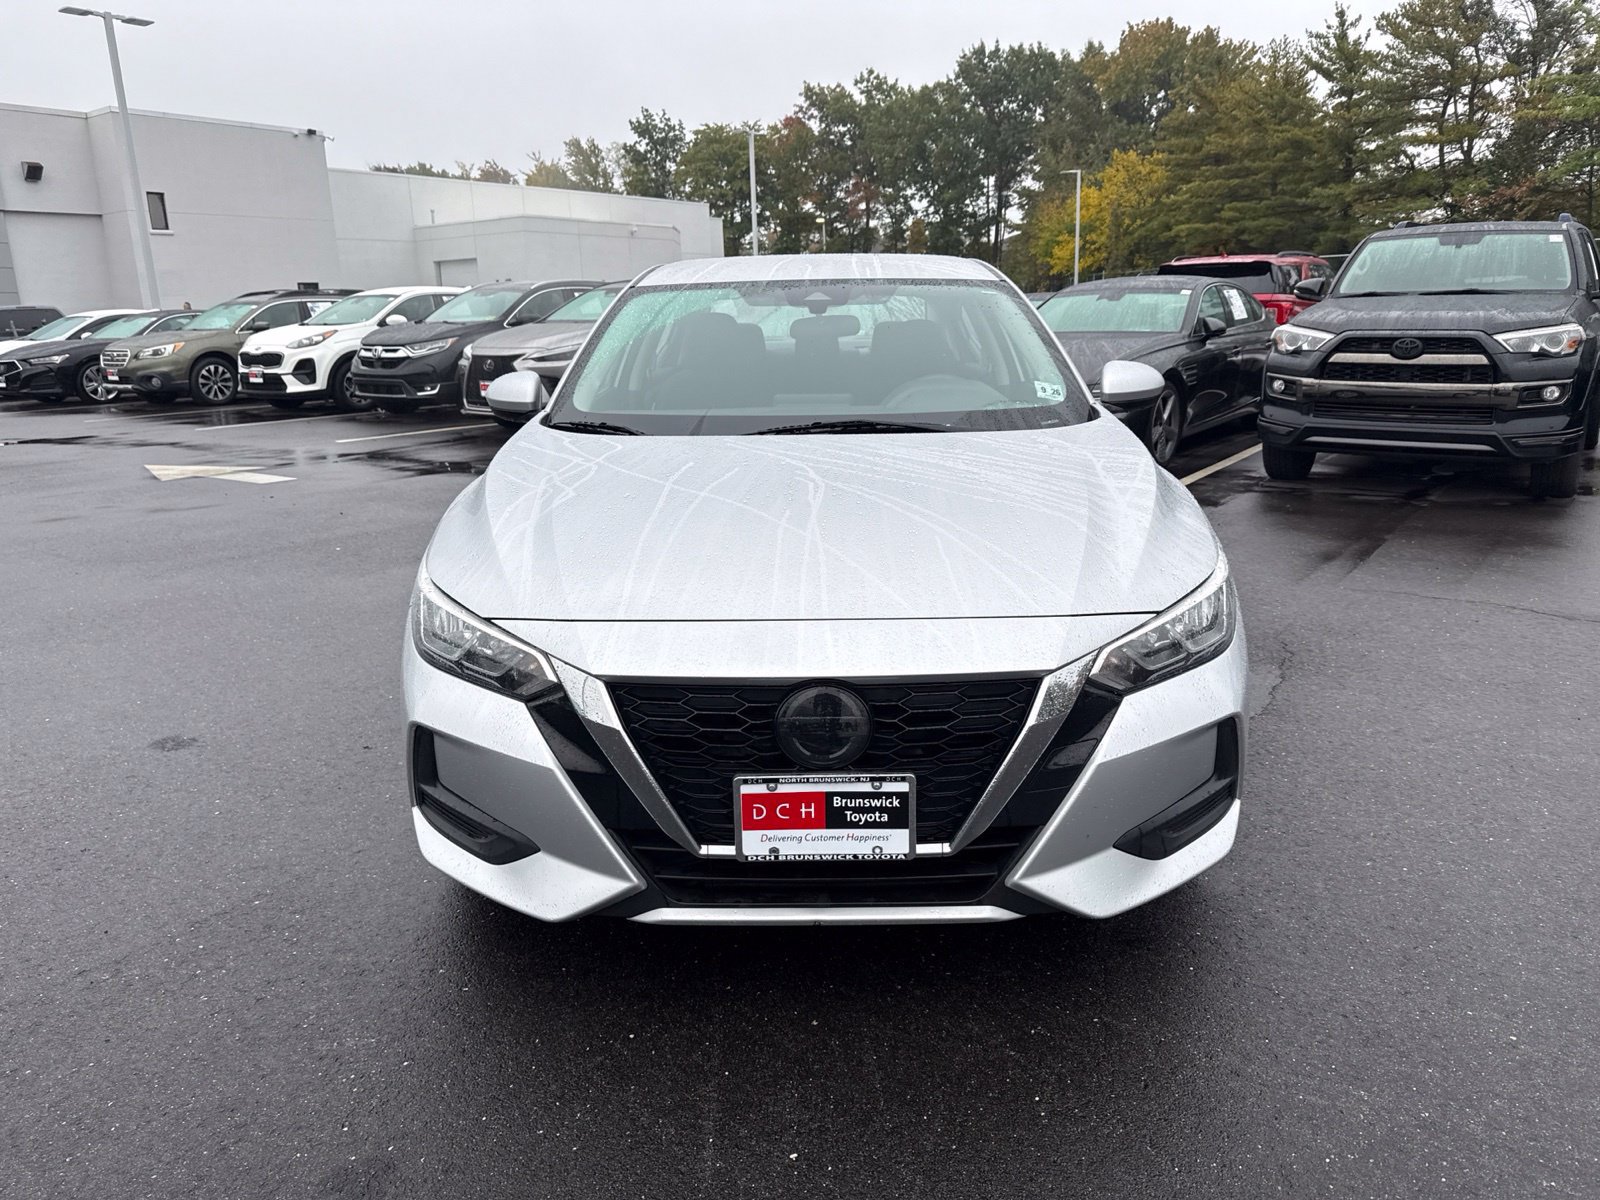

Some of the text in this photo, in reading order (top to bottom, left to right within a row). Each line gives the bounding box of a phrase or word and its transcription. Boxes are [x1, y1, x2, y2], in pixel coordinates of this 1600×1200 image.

[833, 796, 900, 807] Brunswick
[845, 810, 888, 825] Toyota
[760, 833, 803, 844] Delivering
[804, 833, 845, 842] Customer
